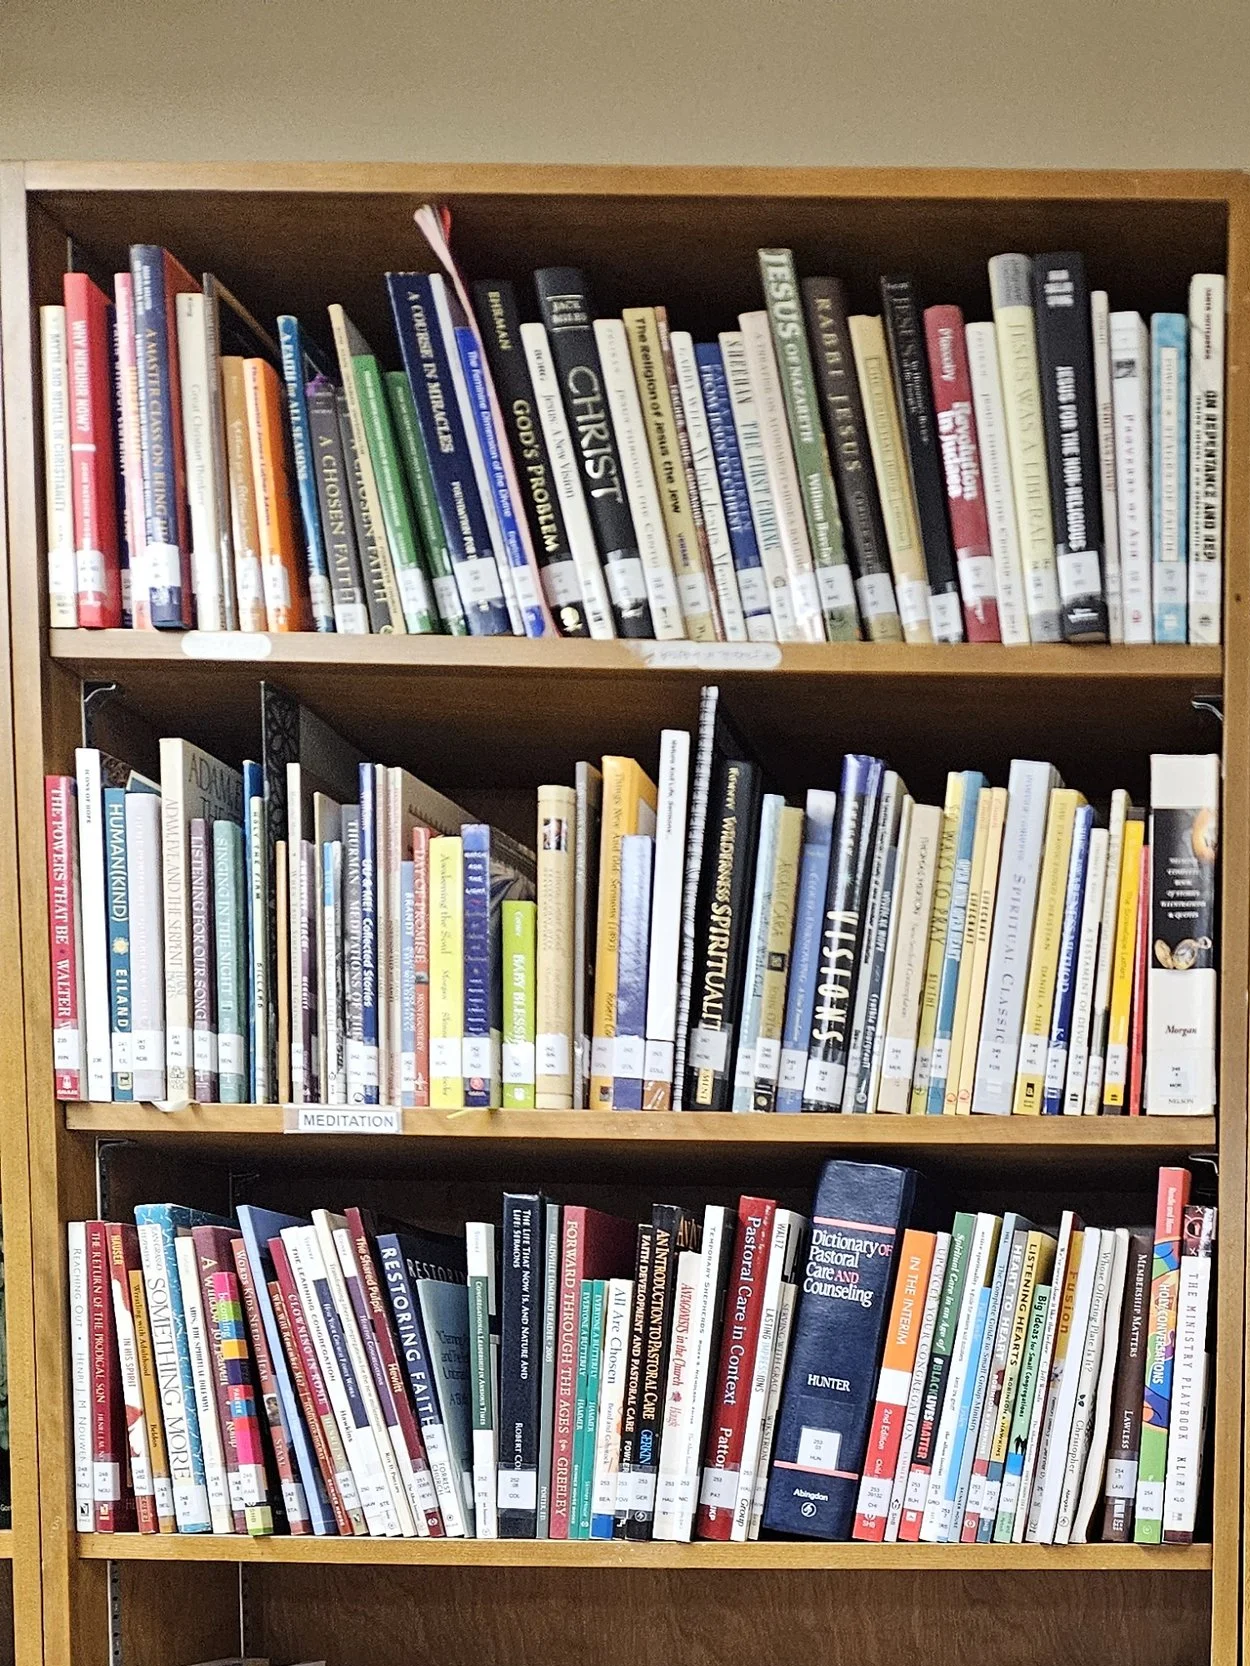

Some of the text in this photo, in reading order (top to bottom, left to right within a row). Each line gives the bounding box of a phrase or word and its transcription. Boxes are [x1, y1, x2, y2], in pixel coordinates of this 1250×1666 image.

[488, 291, 512, 349] EHRMAN
[513, 400, 559, 552] GOD'S PROBLEM
[566, 365, 624, 504] CHRIST
[1055, 365, 1087, 551] JESUS FOR THE NON-RELIGIOUS
[319, 435, 355, 603] A CHOSEN FAITH
[51, 787, 71, 1017] THE POWERS THAT BE WALTER
[108, 803, 128, 923] HUMAN(KIND)
[190, 835, 207, 1020] LISTENING FOR OUR SONG
[813, 910, 858, 1042] VISIONS
[1165, 1024, 1197, 1036] Morgan
[303, 1114, 394, 1127] MEDITATION
[803, 1278, 873, 1308] Counseling
[806, 1262, 859, 1284] Care AND
[810, 1246, 859, 1268] Pastoral
[811, 1228, 876, 1258] Dictionary
[895, 1256, 921, 1345] IN THE INTERIM
[381, 1246, 436, 1428] RESTORING FAITH
[558, 1220, 578, 1434] FORWARD THROUGH THE AGES
[723, 1216, 761, 1405] Pastoral Care in Context
[148, 1277, 191, 1480] SOMETHING MORE
[807, 1373, 851, 1392] HUNTER
[555, 1457, 568, 1517] GREELEY
[793, 1488, 829, 1502] Abingdon
